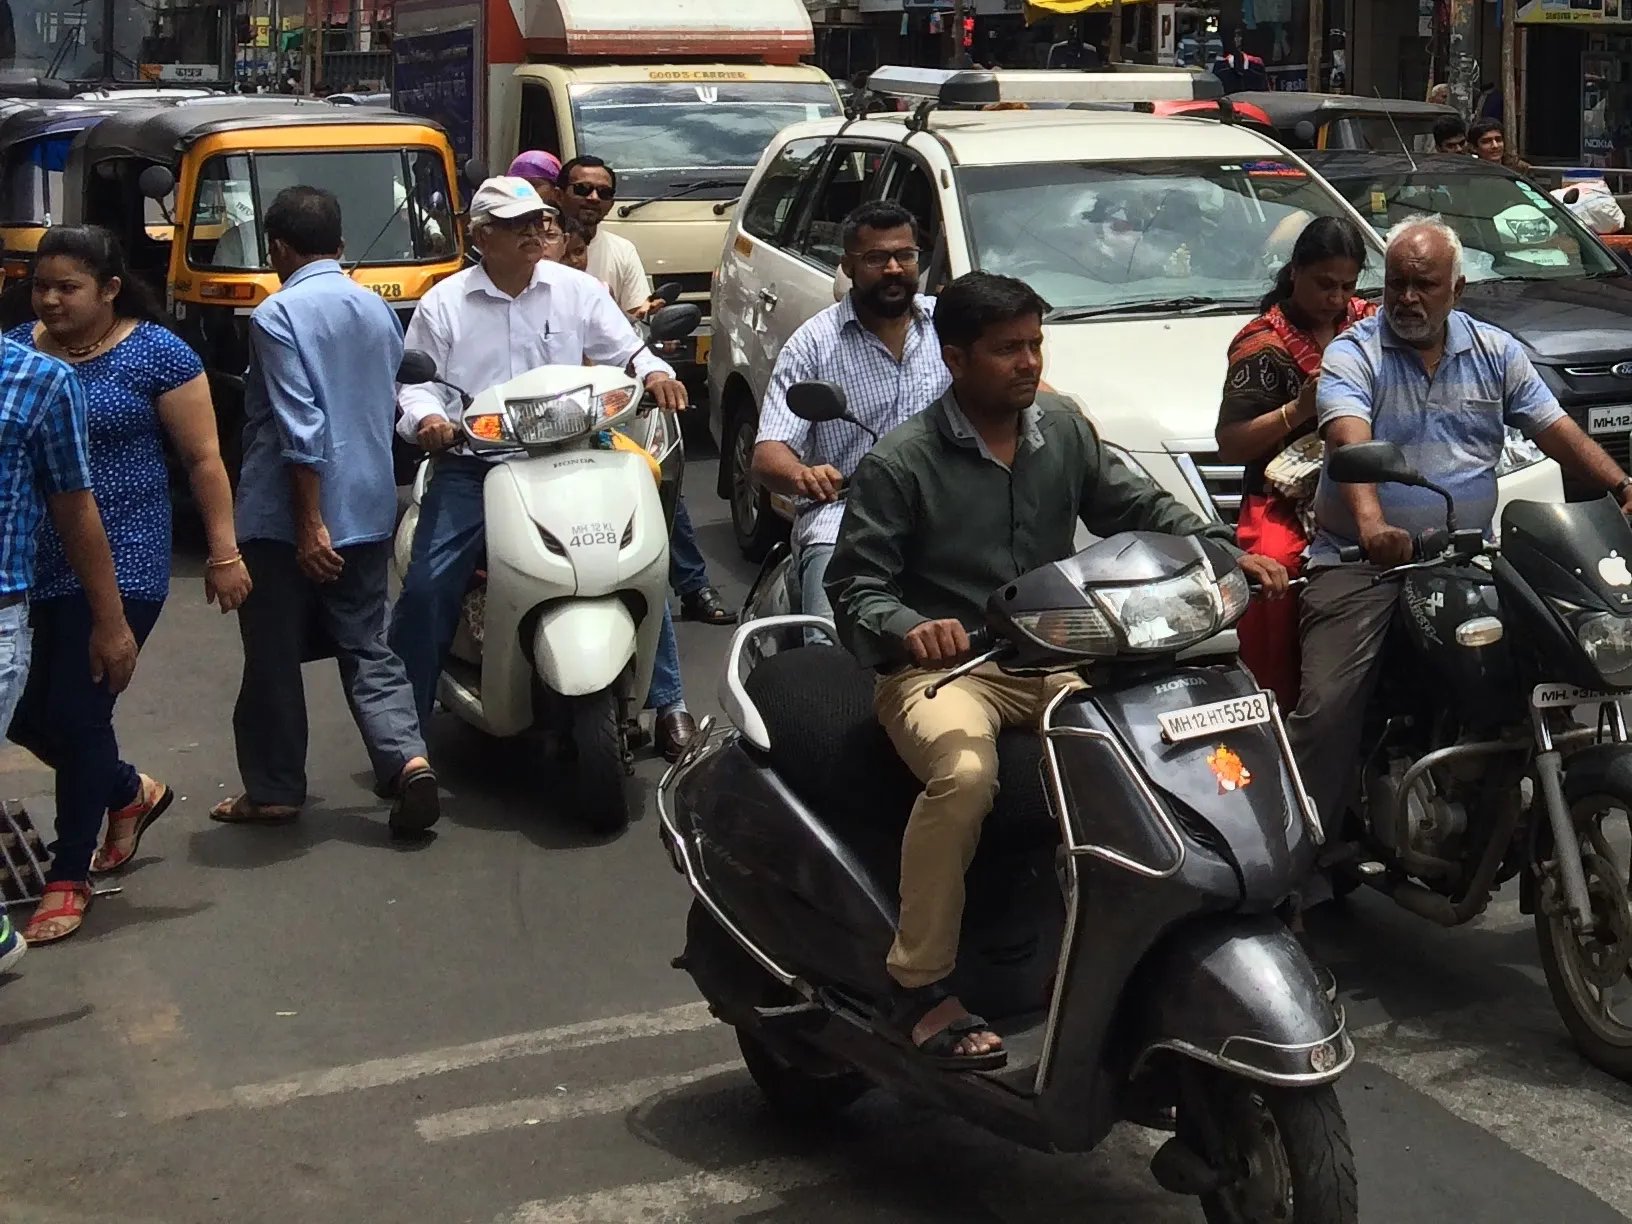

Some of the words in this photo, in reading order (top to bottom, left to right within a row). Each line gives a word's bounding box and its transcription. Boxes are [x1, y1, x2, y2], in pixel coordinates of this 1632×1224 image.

[693, 71, 746, 80] CARRIER
[1280, 78, 1307, 92] Fash
[1584, 138, 1614, 149] NOKIA
[553, 458, 595, 469] HONDA
[570, 532, 617, 548] 4028
[1154, 676, 1208, 695] HONDA
